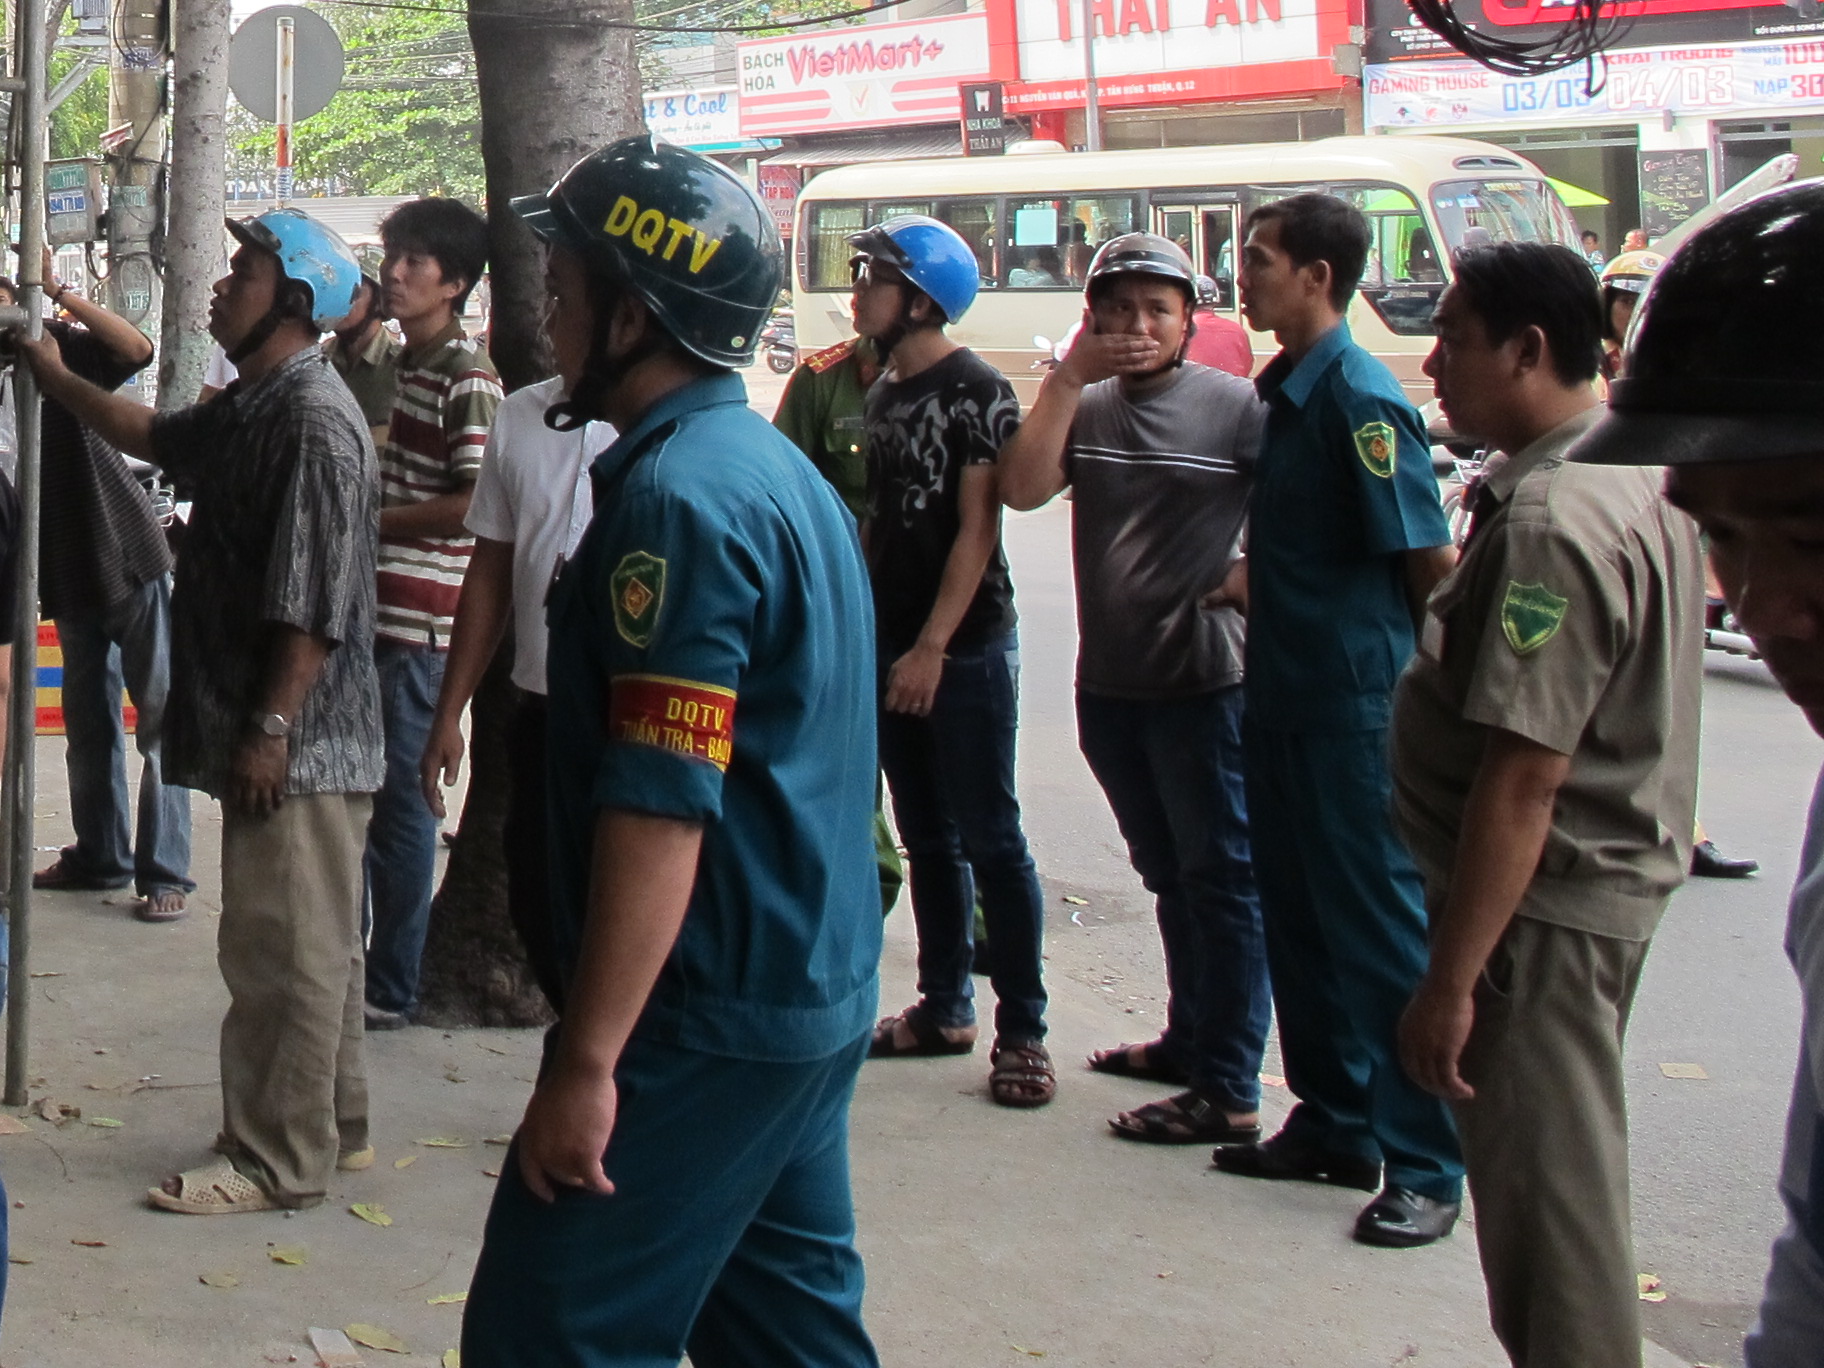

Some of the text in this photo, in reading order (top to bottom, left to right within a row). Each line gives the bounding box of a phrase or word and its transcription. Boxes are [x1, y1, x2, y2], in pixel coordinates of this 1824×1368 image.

[743, 50, 784, 70] BÁCH
[744, 71, 775, 92] HÓA
[1369, 72, 1489, 94] GAMING HOUSE
[1503, 78, 1590, 111] 03/03
[1607, 64, 1735, 111] 04/03
[684, 92, 729, 116] Cool
[603, 195, 721, 274] DQTV
[665, 697, 725, 731] DQTV
[663, 727, 694, 754] TRA
